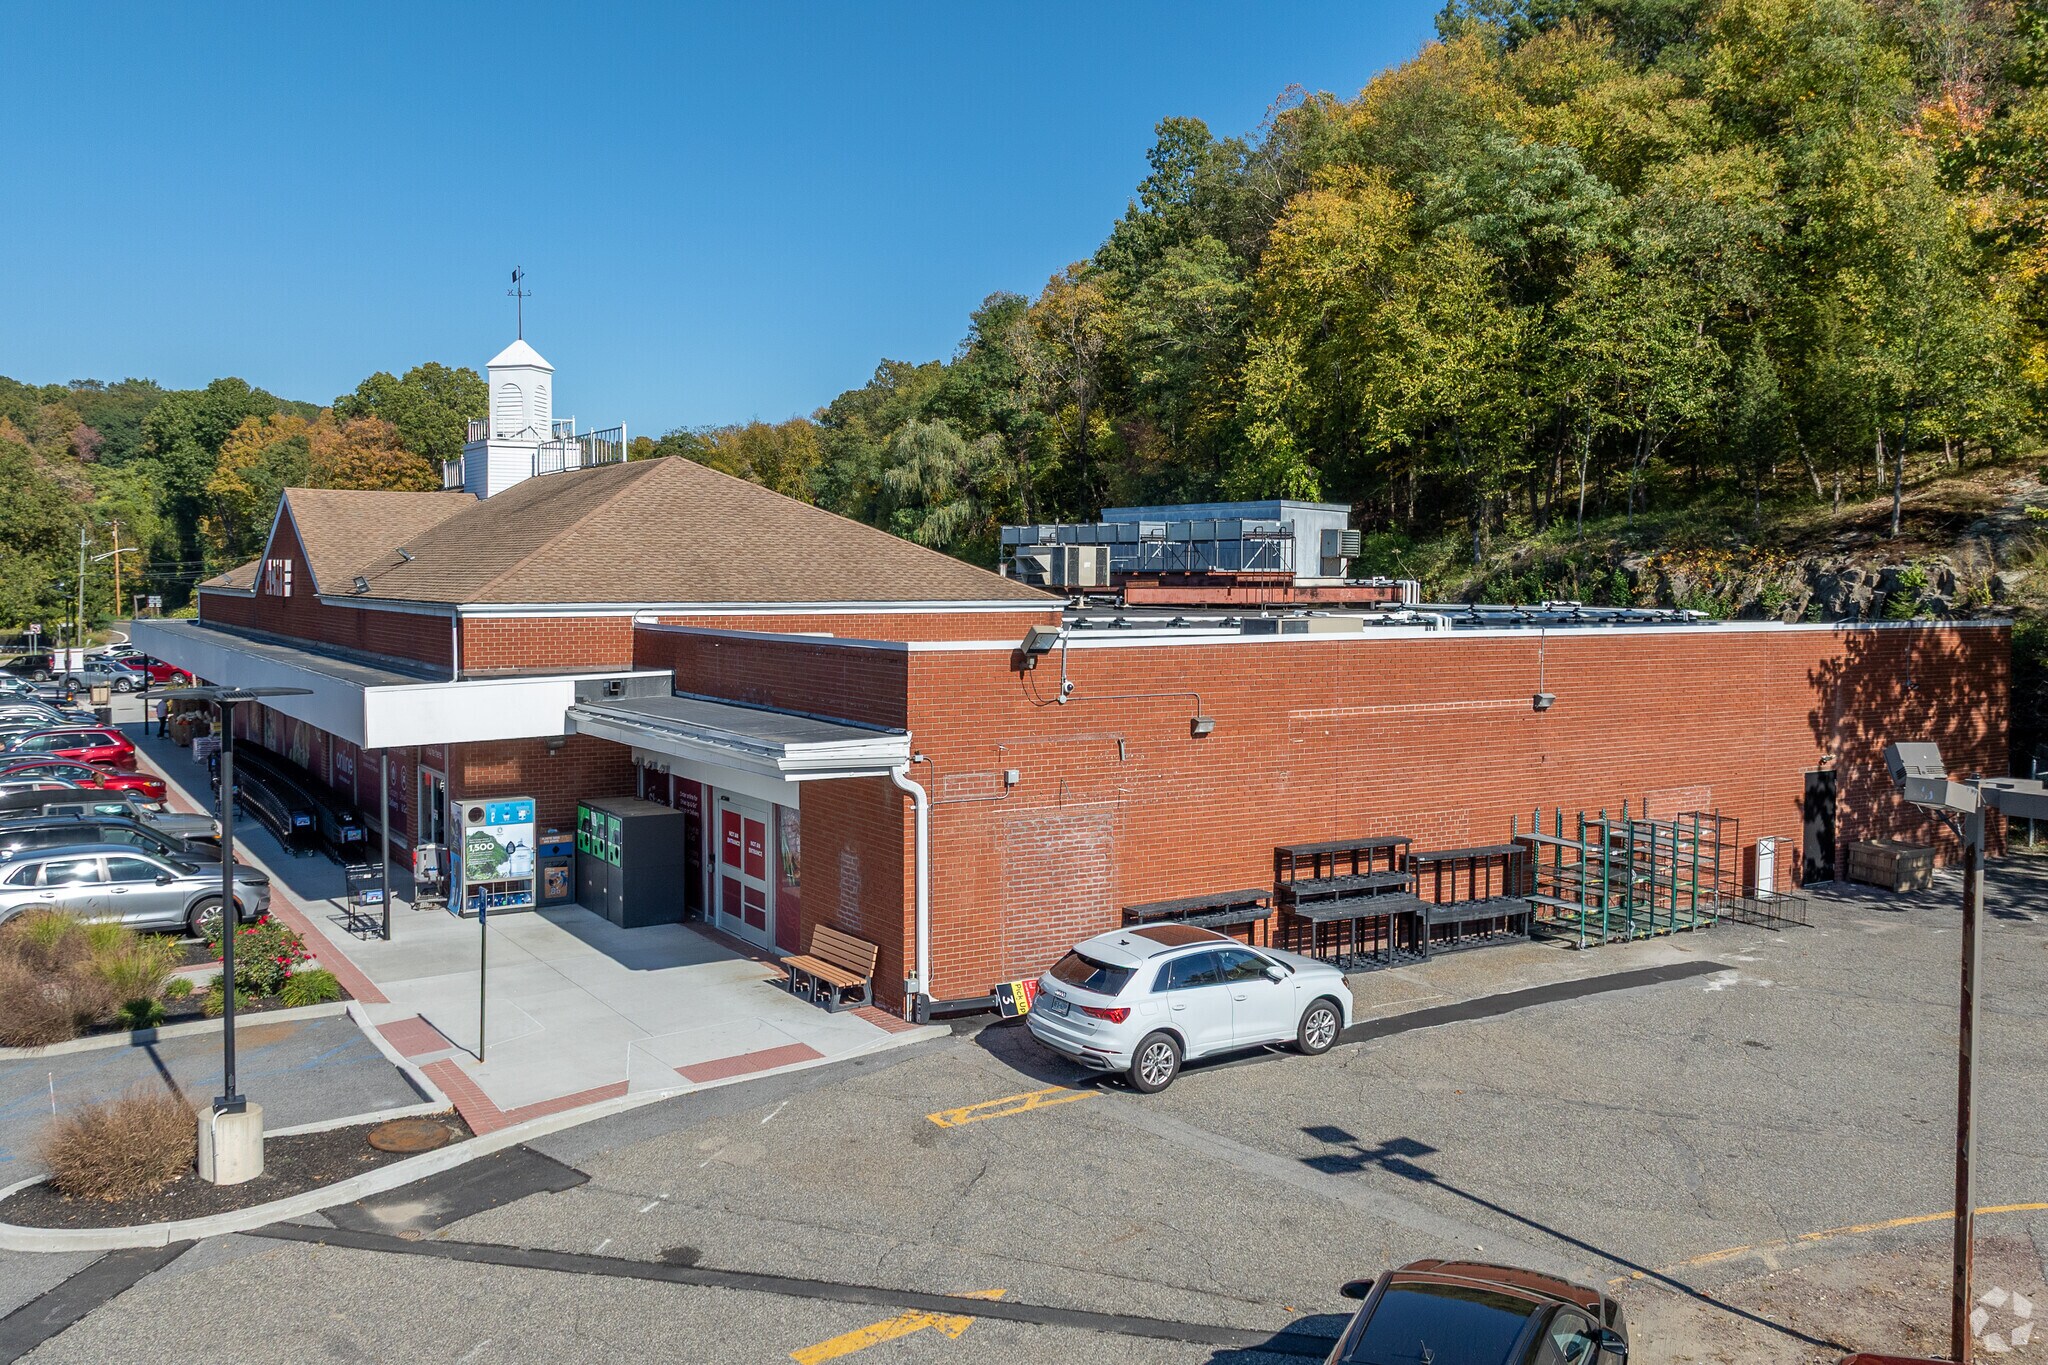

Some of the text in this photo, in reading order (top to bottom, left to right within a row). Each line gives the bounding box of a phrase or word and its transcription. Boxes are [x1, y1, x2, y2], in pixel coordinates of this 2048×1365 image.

[468, 842, 495, 853] 1,500
[1002, 995, 1014, 1005] 3
[1015, 983, 1026, 1013] Pick Up
